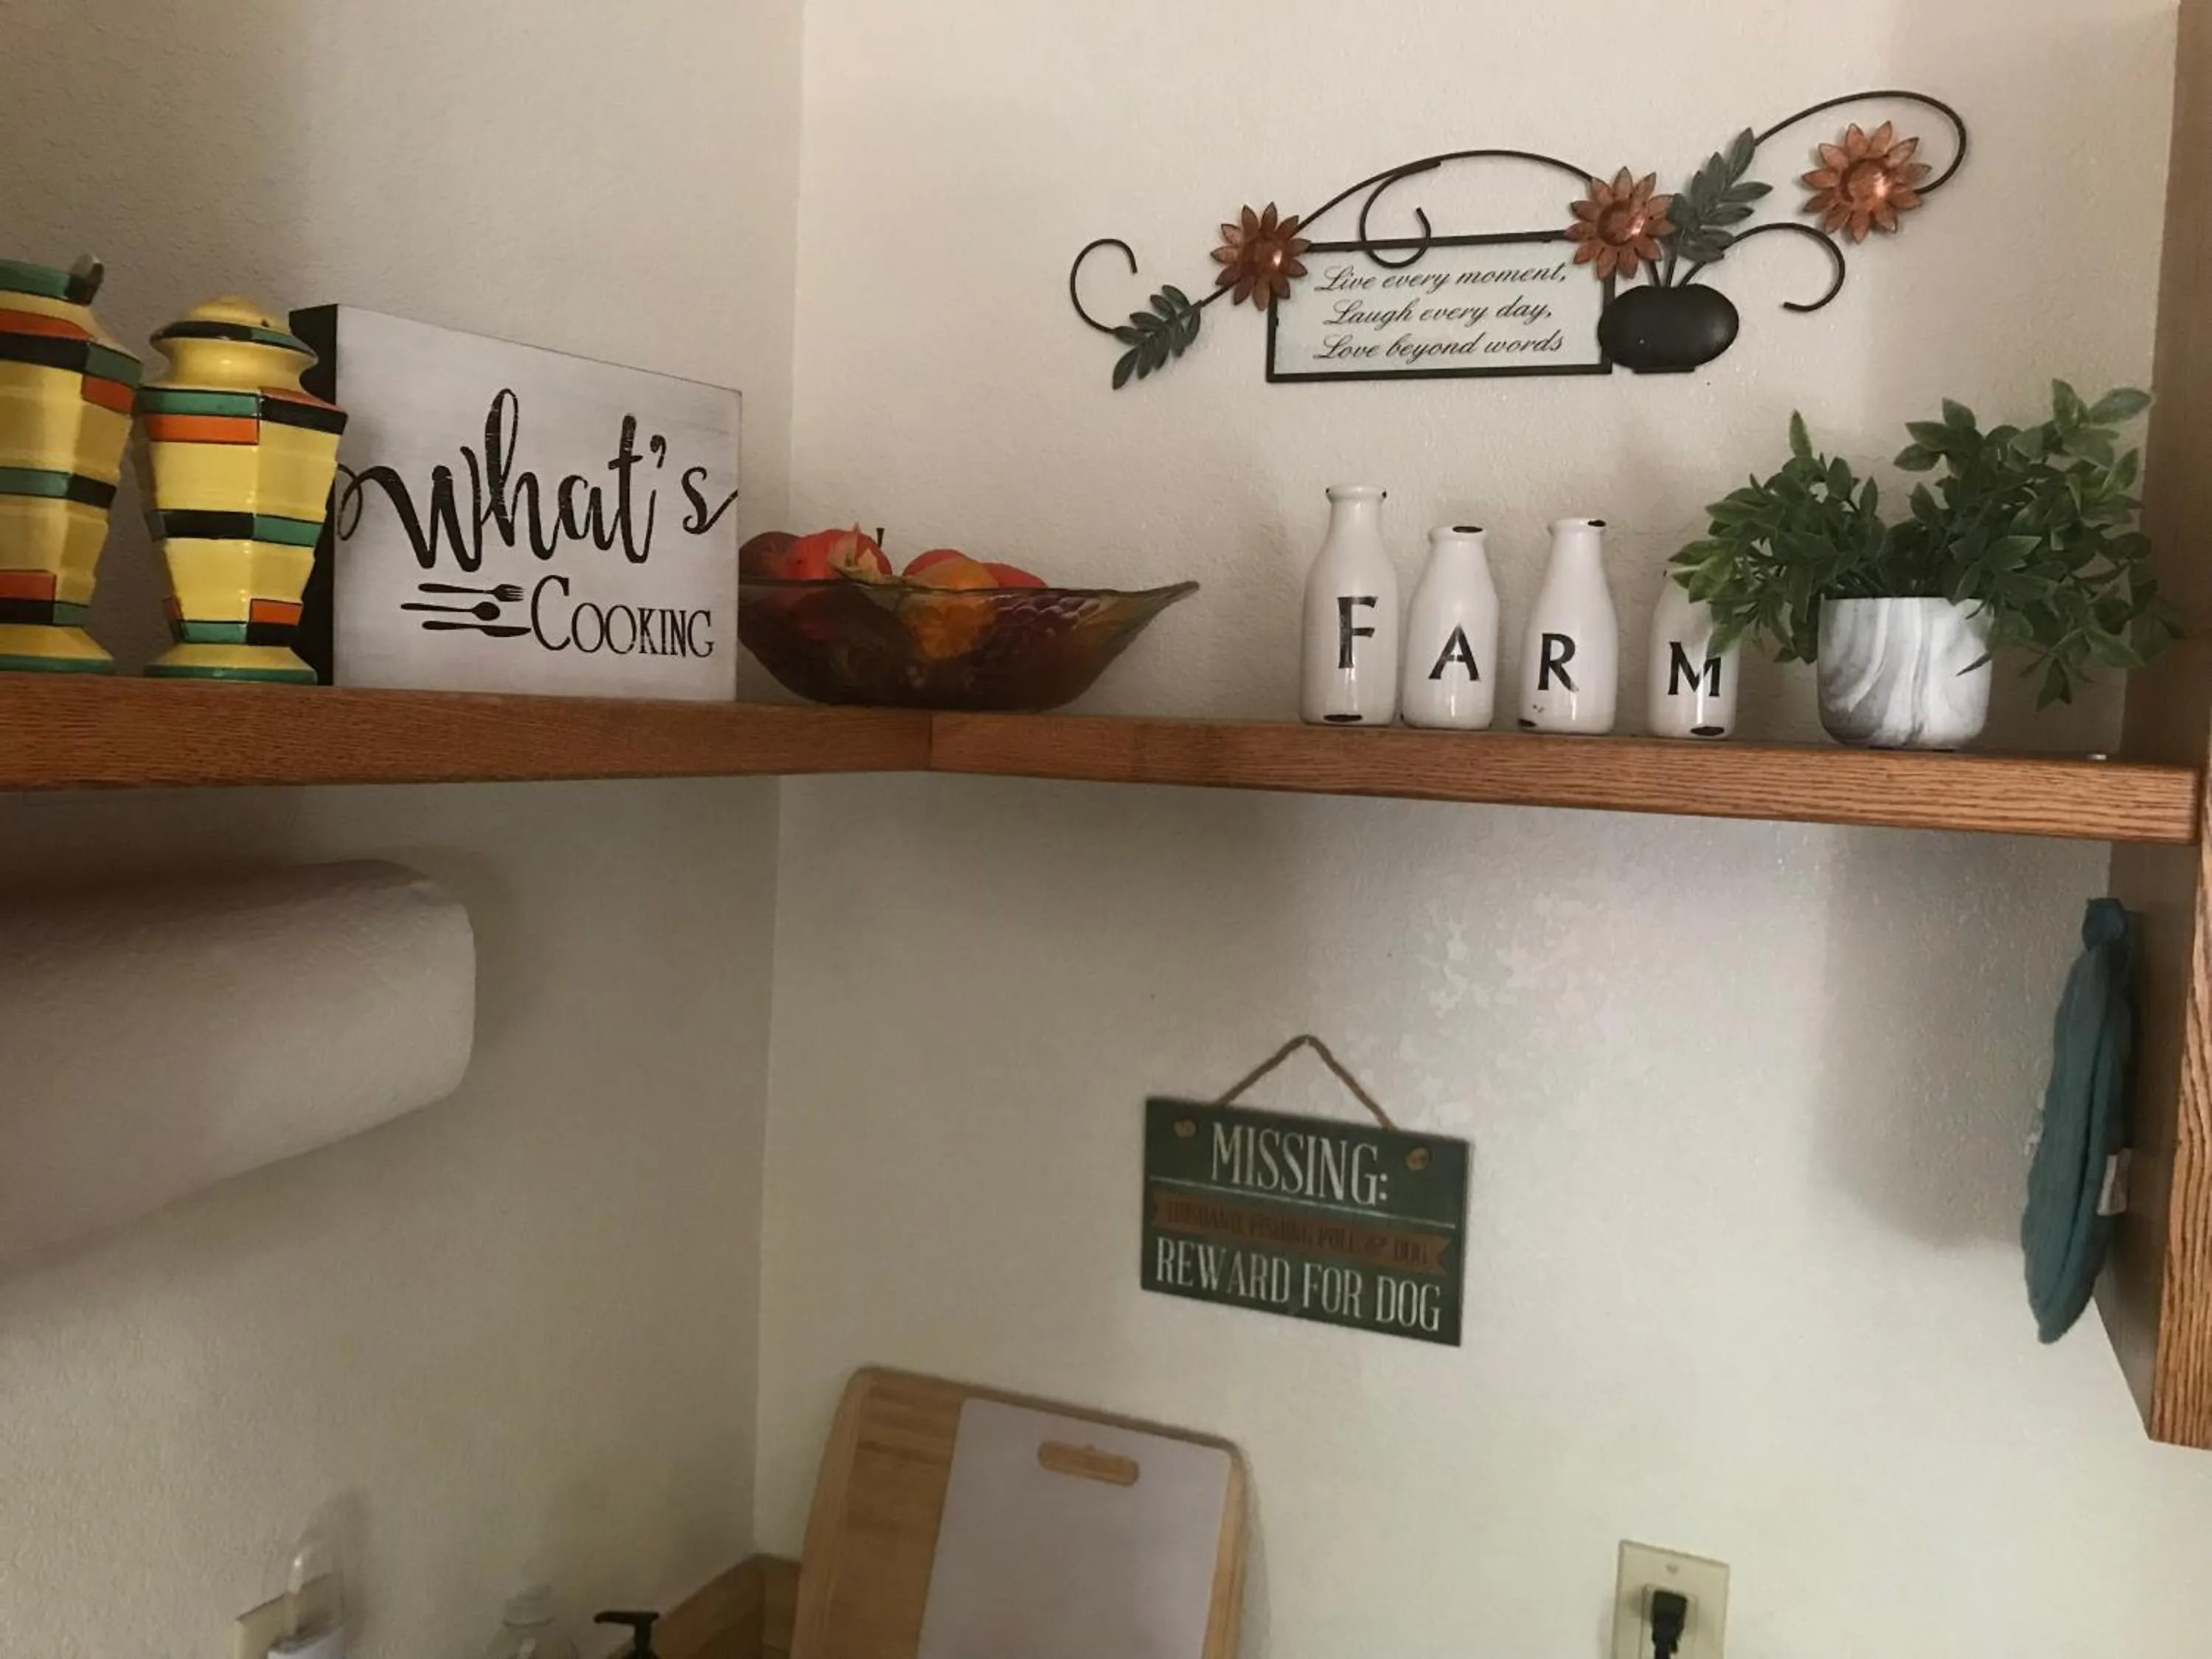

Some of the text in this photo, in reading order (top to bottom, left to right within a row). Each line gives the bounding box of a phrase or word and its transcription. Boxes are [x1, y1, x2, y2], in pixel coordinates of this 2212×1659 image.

[1314, 262, 1565, 294] Live every moment,
[1323, 295, 1551, 331] Laugh every day,
[1312, 329, 1563, 364] Love beyond words
[1211, 1121, 1388, 1206] MISSING:
[1155, 1236, 1441, 1333] REWARD FOR DOG
